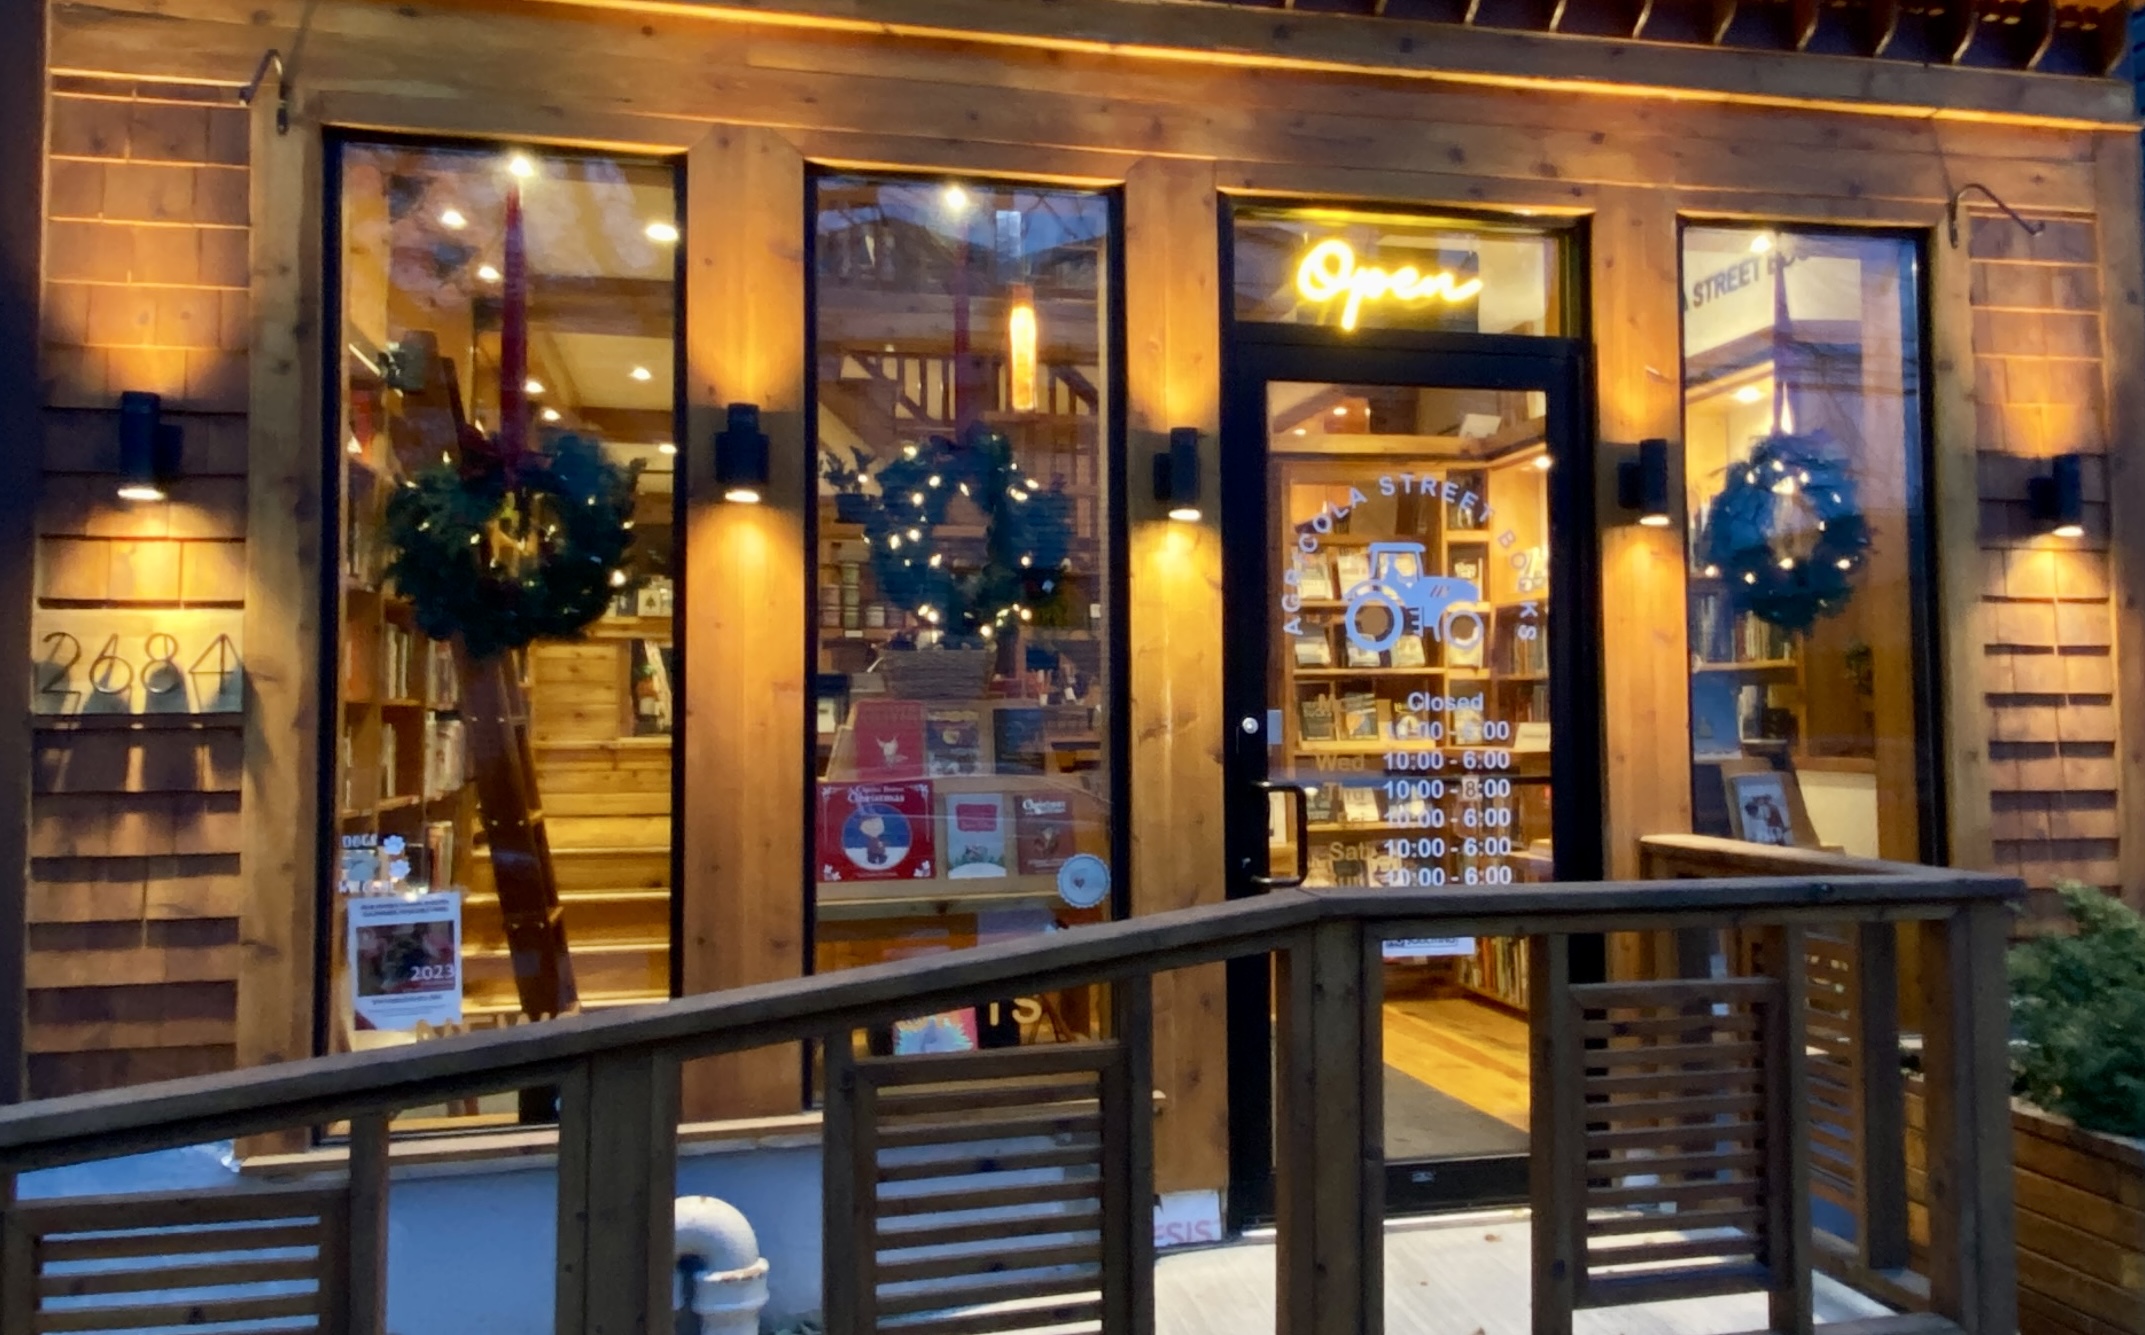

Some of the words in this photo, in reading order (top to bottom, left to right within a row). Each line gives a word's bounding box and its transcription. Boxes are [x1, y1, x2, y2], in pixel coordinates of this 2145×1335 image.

[1296, 238, 1484, 332] Open
[1692, 256, 1762, 309] STREET
[1281, 486, 1368, 637] AGRICOLA
[1378, 473, 1495, 523] STREET
[1496, 529, 1538, 642] BOOKS
[42, 631, 236, 695] 2684
[1407, 691, 1484, 712] Closed
[1315, 754, 1365, 772] Wed
[1383, 751, 1444, 770] 10:00
[1463, 750, 1510, 769] 6:00
[1383, 780, 1445, 799] 1000
[1463, 778, 1511, 799] 8:00
[1464, 808, 1511, 827] 6:00
[1384, 838, 1445, 858] 10:00
[1464, 837, 1512, 856] 6:00
[1384, 867, 1446, 887] 10:00
[1464, 866, 1513, 886] 6:00
[410, 965, 455, 981] 2023
